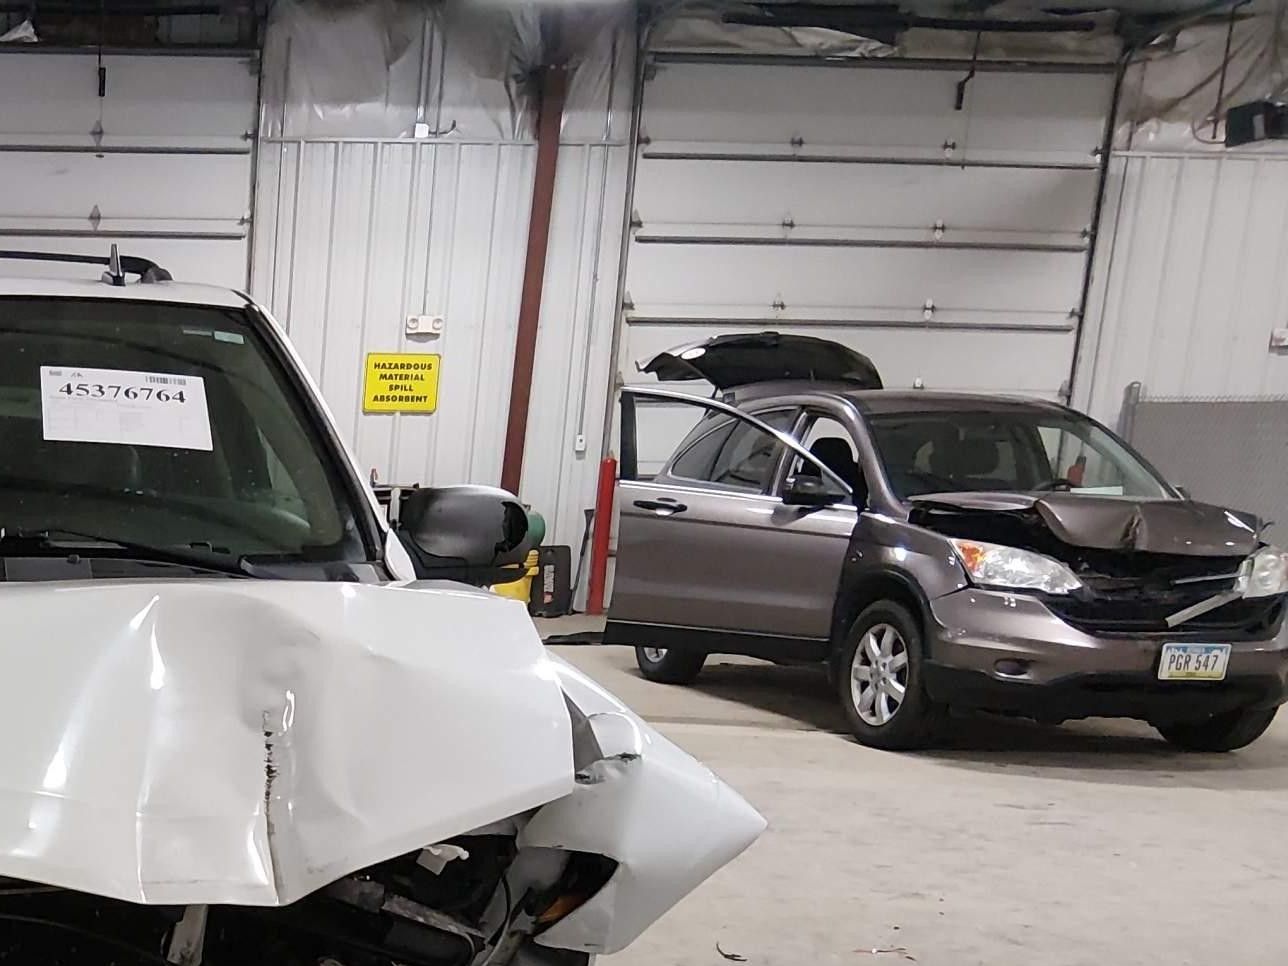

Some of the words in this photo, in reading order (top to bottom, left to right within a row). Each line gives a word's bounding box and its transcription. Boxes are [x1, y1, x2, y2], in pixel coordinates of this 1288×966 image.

[374, 362, 432, 371] HAZARDOUS
[379, 373, 424, 381] MATERIAL
[59, 383, 187, 403] 45376764
[1168, 654, 1191, 671] PGR
[1195, 654, 1219, 671] 547
